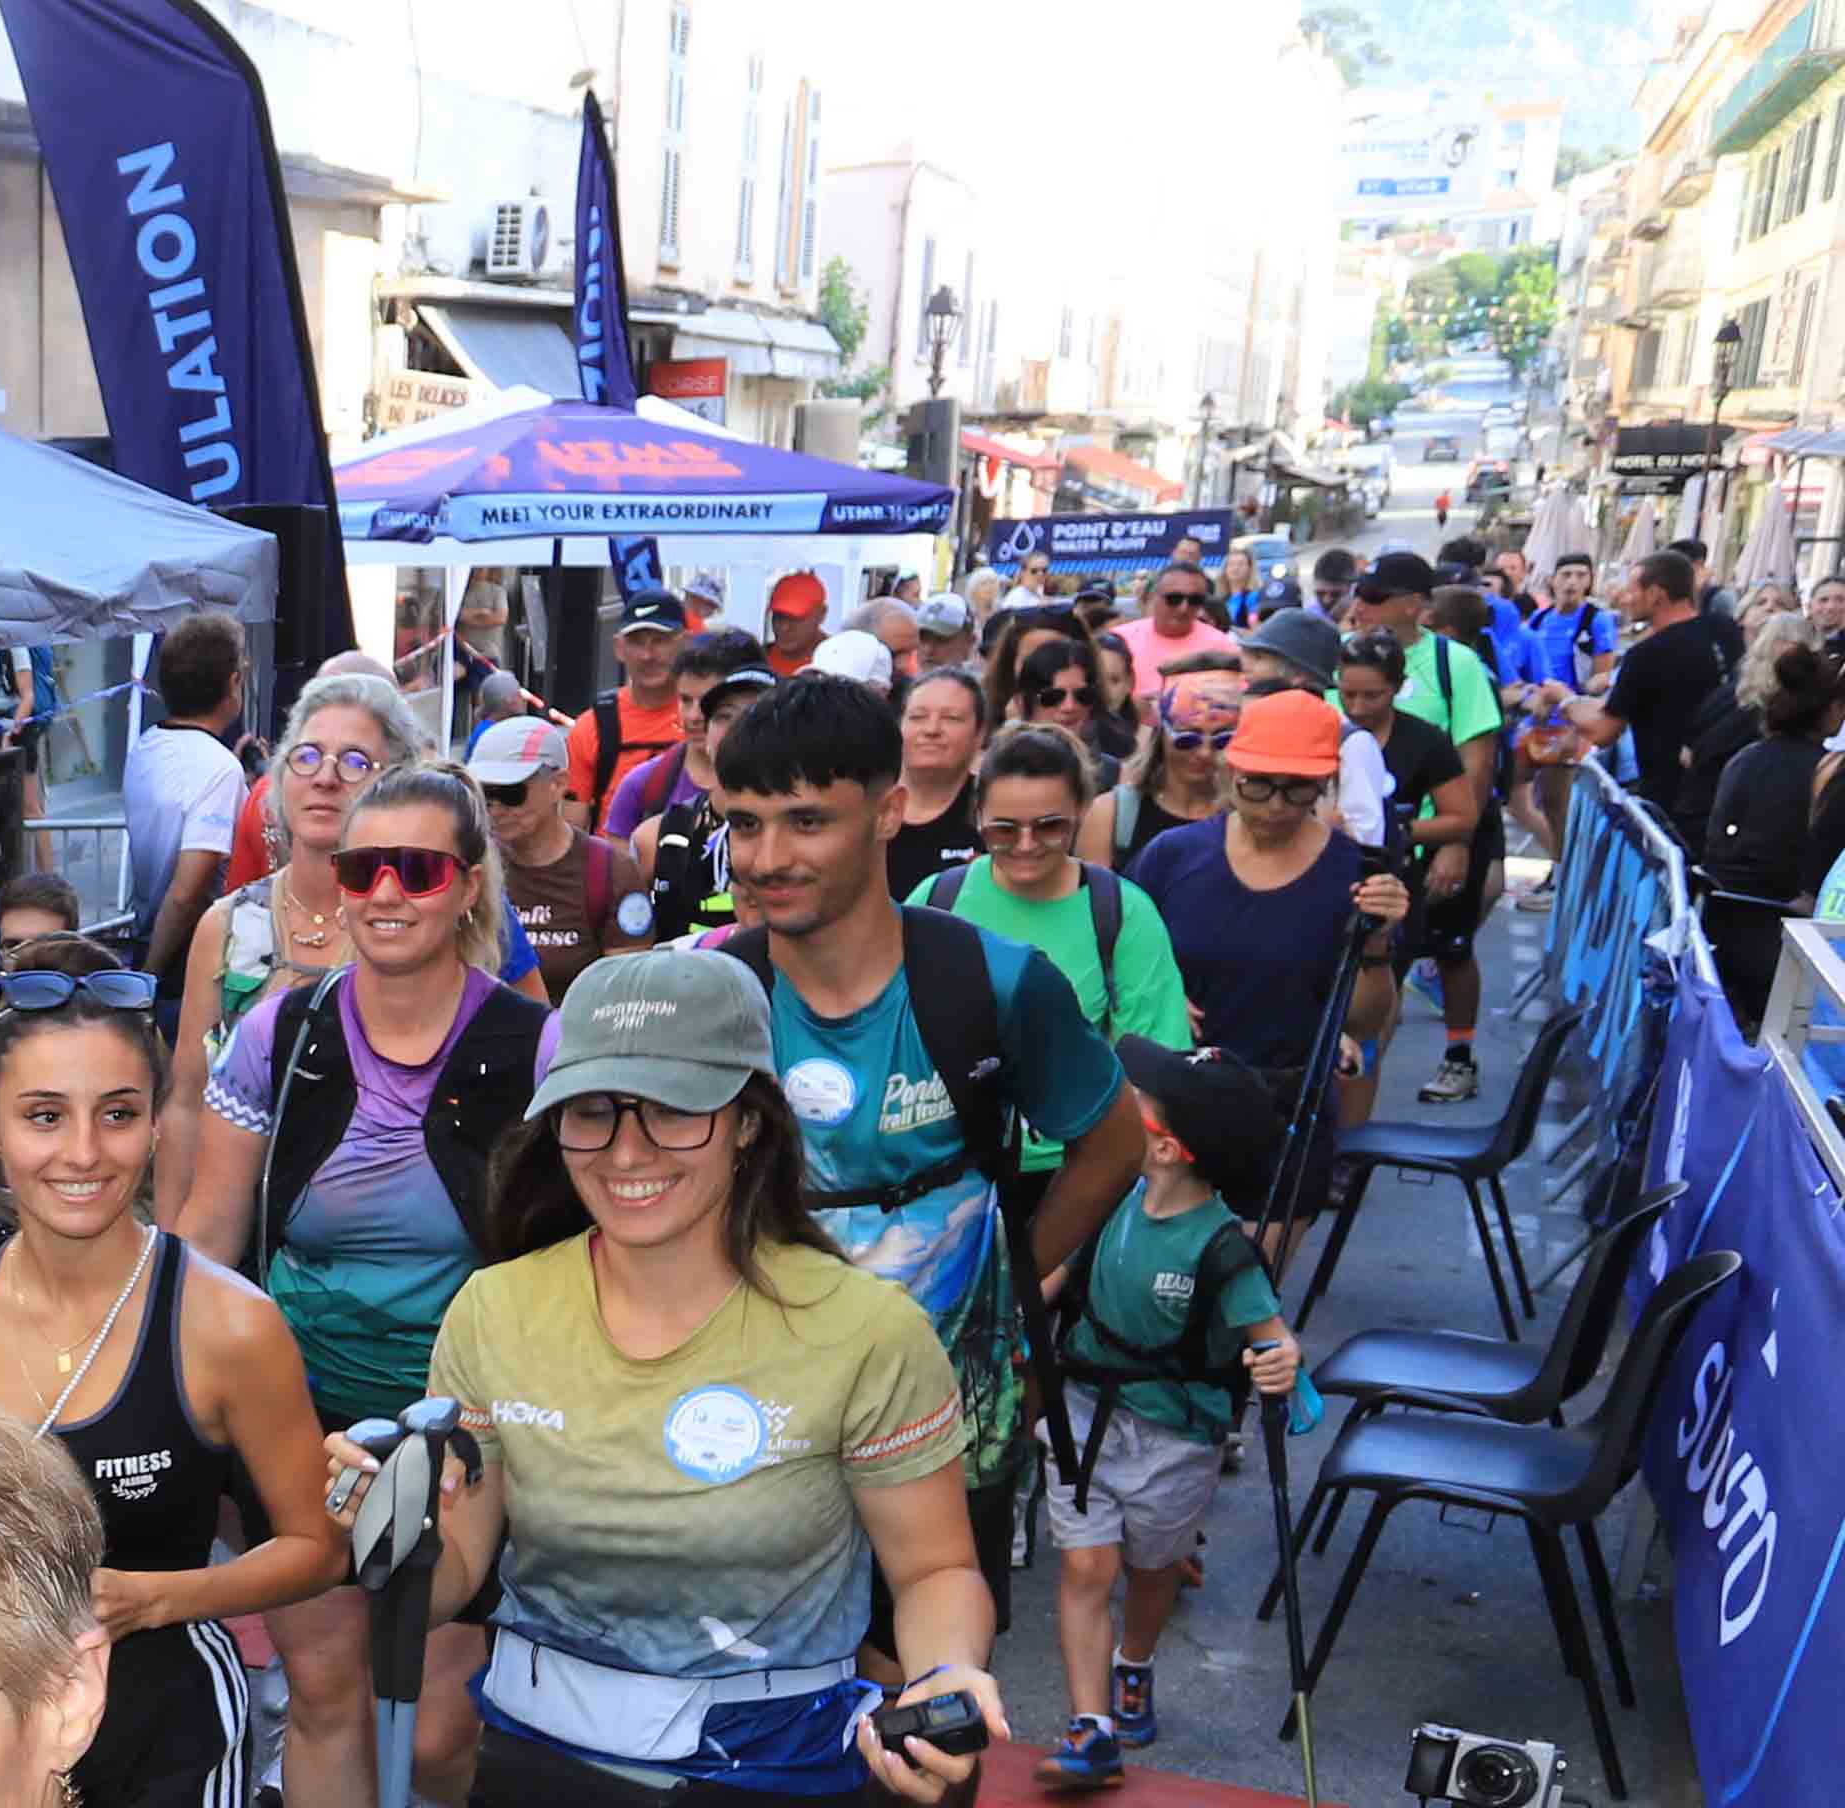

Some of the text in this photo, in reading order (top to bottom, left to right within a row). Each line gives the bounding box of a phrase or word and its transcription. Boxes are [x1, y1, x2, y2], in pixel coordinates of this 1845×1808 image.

[116, 141, 243, 508] ULATION
[482, 501, 774, 526] MEET YOUR EXTRAORDINARY
[1052, 519, 1167, 539] POINT D'EAU
[95, 1449, 173, 1478] FITNESS
